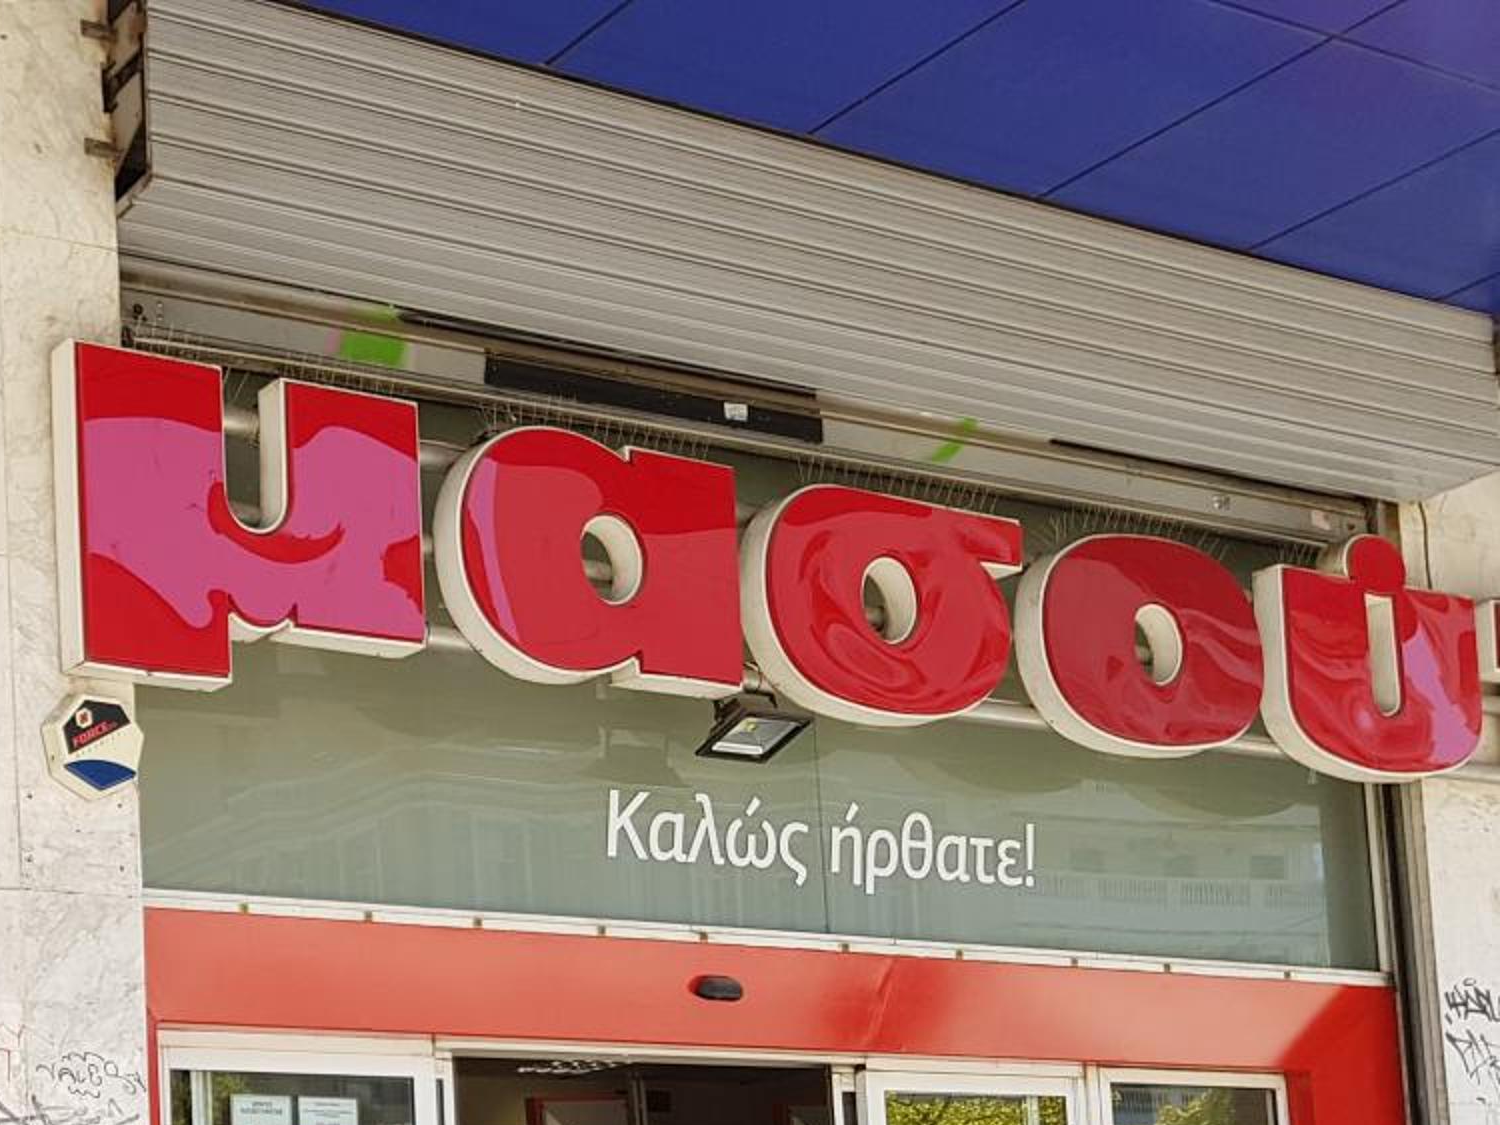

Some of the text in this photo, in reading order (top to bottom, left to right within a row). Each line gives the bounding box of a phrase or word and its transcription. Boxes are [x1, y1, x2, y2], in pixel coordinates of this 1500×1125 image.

[56, 338, 1500, 784] μασού
[607, 788, 1035, 895] Καλώς ήρθατε!
